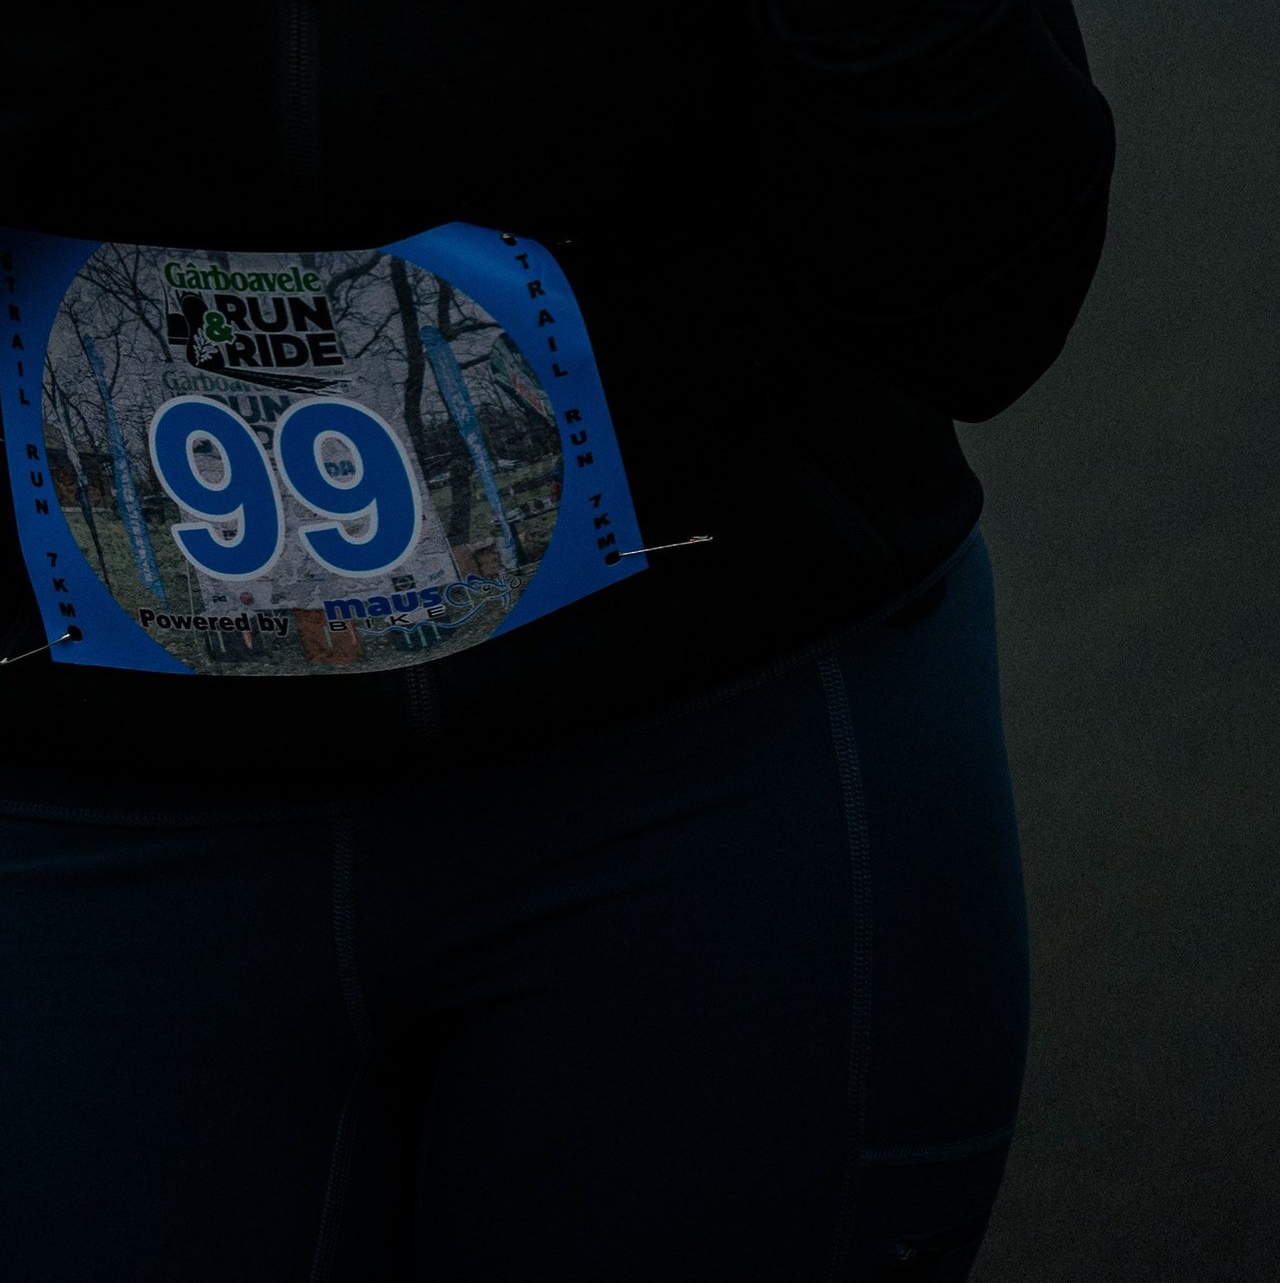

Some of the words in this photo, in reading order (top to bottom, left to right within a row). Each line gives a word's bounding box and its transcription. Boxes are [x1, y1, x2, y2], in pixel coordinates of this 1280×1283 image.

[164, 262, 321, 293] Gârboavele
[205, 312, 235, 343] &
[214, 294, 334, 332] RUN
[226, 334, 344, 367] RIDE
[515, 253, 568, 378] TRAIL
[564, 408, 594, 468] RUN
[589, 493, 616, 551] 7KM
[6, 276, 30, 406] TRAIL
[26, 444, 50, 515] RUN
[46, 552, 76, 619] 7KM
[150, 396, 421, 581] 99
[324, 584, 443, 622] maus
[328, 605, 447, 632] BIKE
[139, 609, 251, 632] Powered
[258, 609, 289, 637] by
